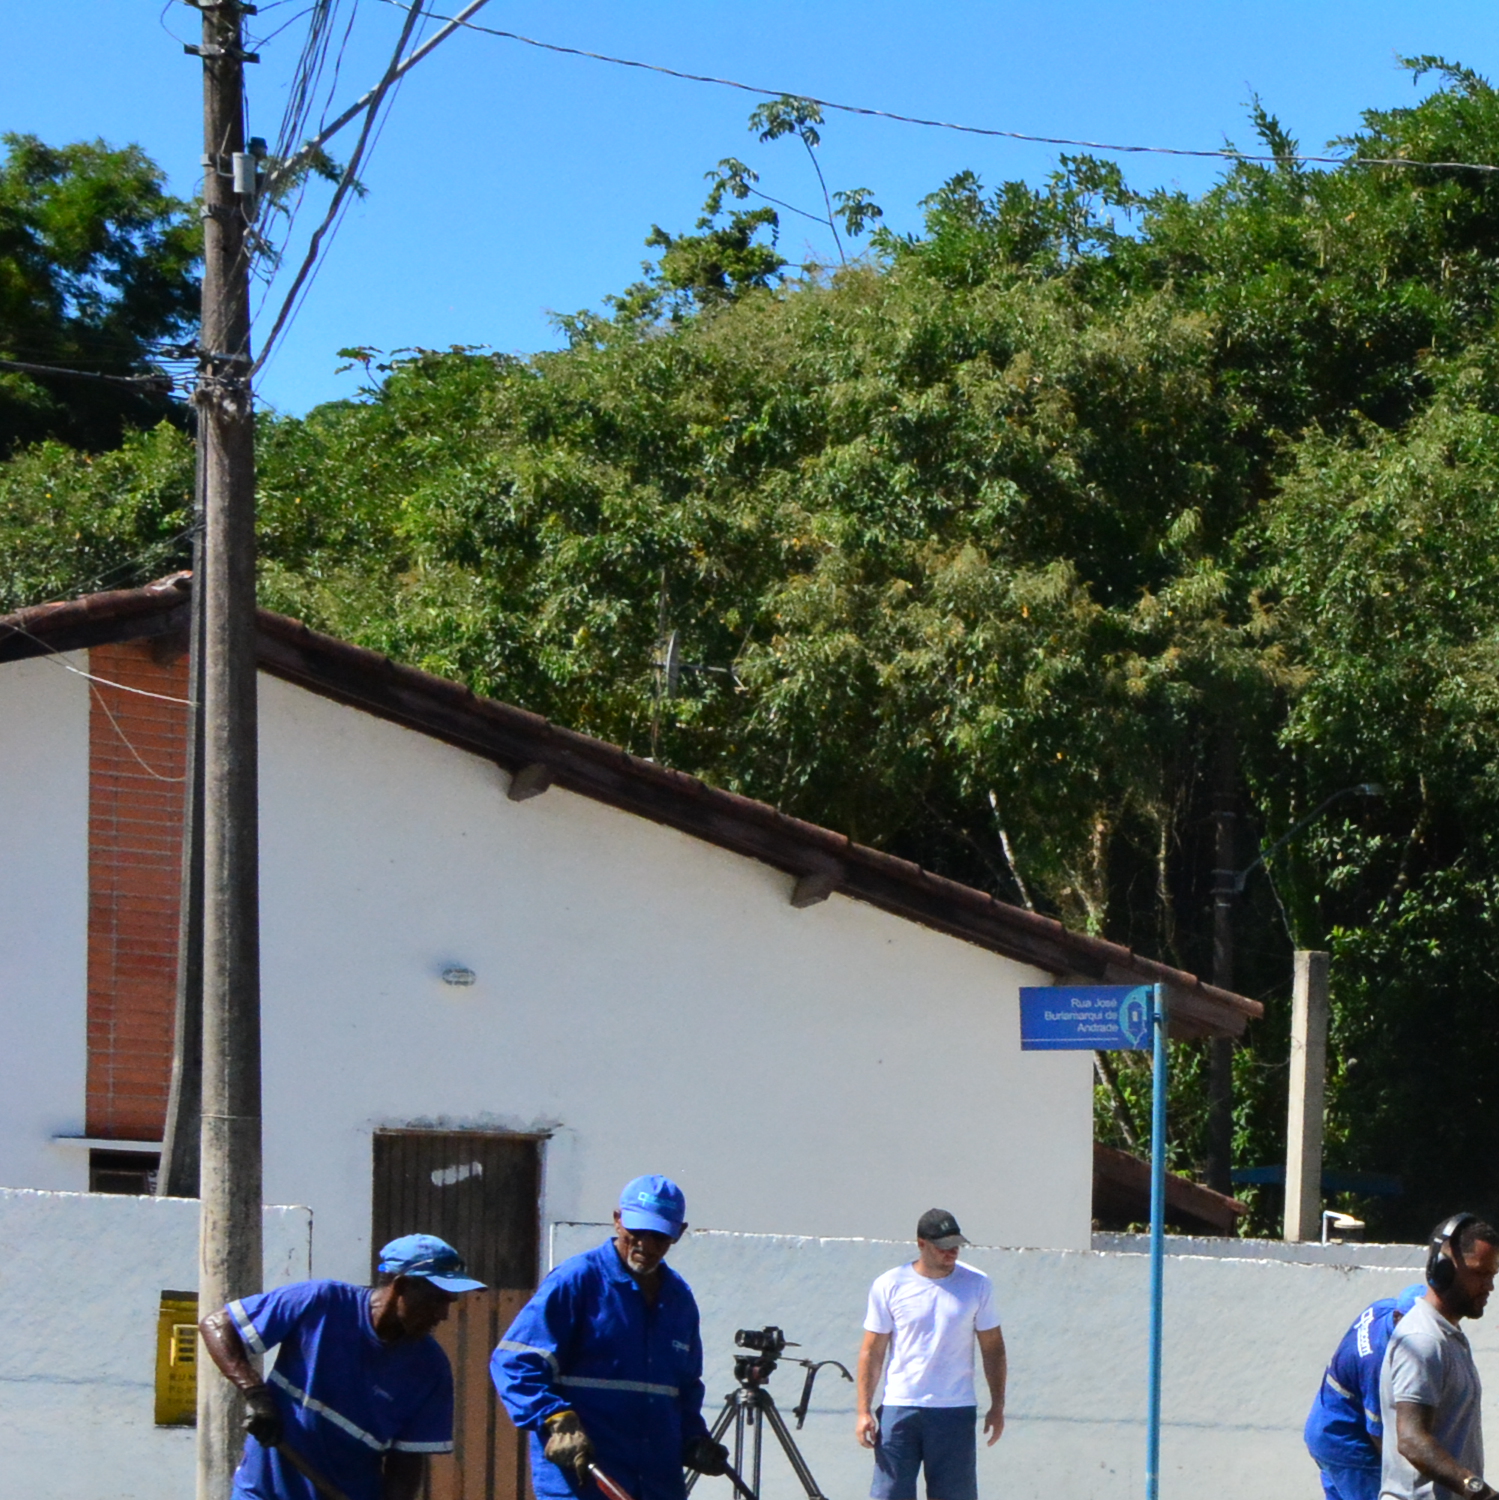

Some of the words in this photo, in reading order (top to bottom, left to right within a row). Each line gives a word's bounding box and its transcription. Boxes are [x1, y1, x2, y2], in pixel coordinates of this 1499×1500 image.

[1071, 998, 1092, 1008] Rua
[1094, 998, 1117, 1008] José
[1077, 1023, 1119, 1032] Andrade
